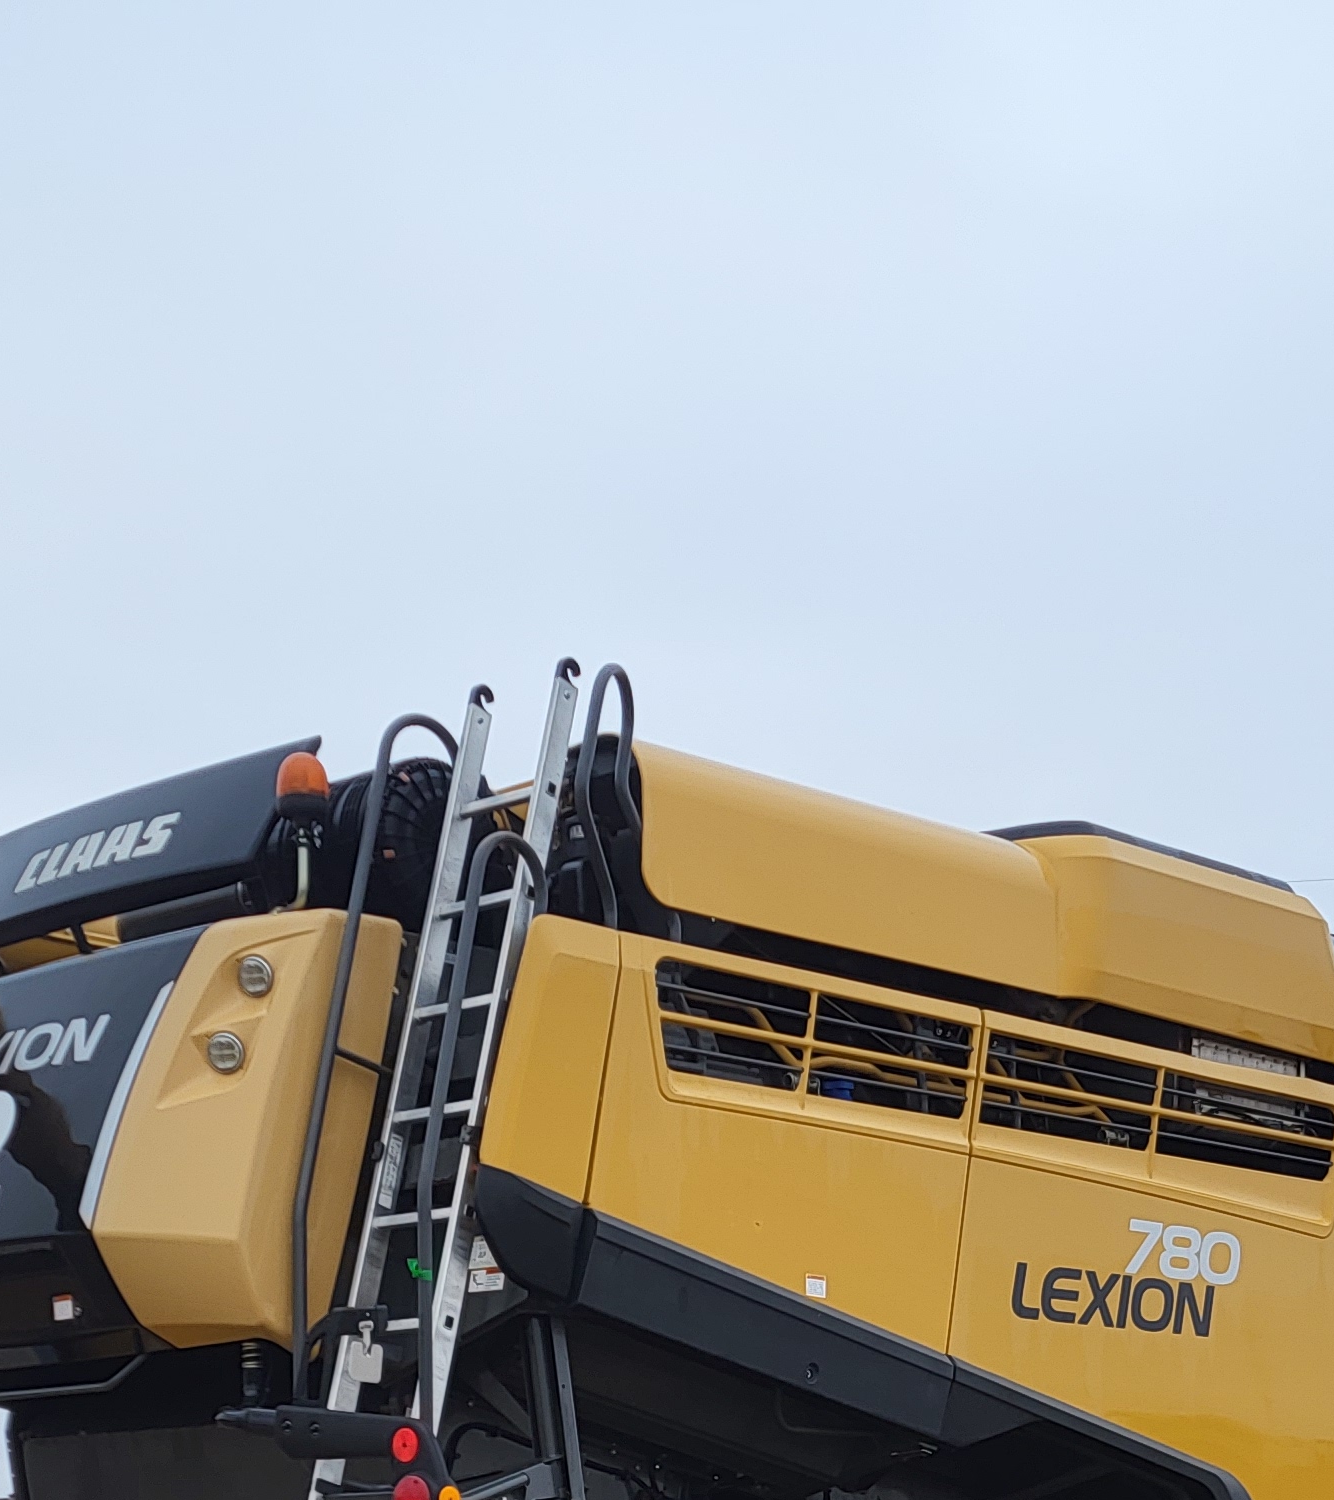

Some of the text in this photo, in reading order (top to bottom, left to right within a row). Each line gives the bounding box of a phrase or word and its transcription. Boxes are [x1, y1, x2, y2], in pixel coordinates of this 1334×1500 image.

[14, 811, 182, 894] CLAAS
[1124, 1218, 1242, 1286] 780
[1011, 1261, 1216, 1338] LEXION
